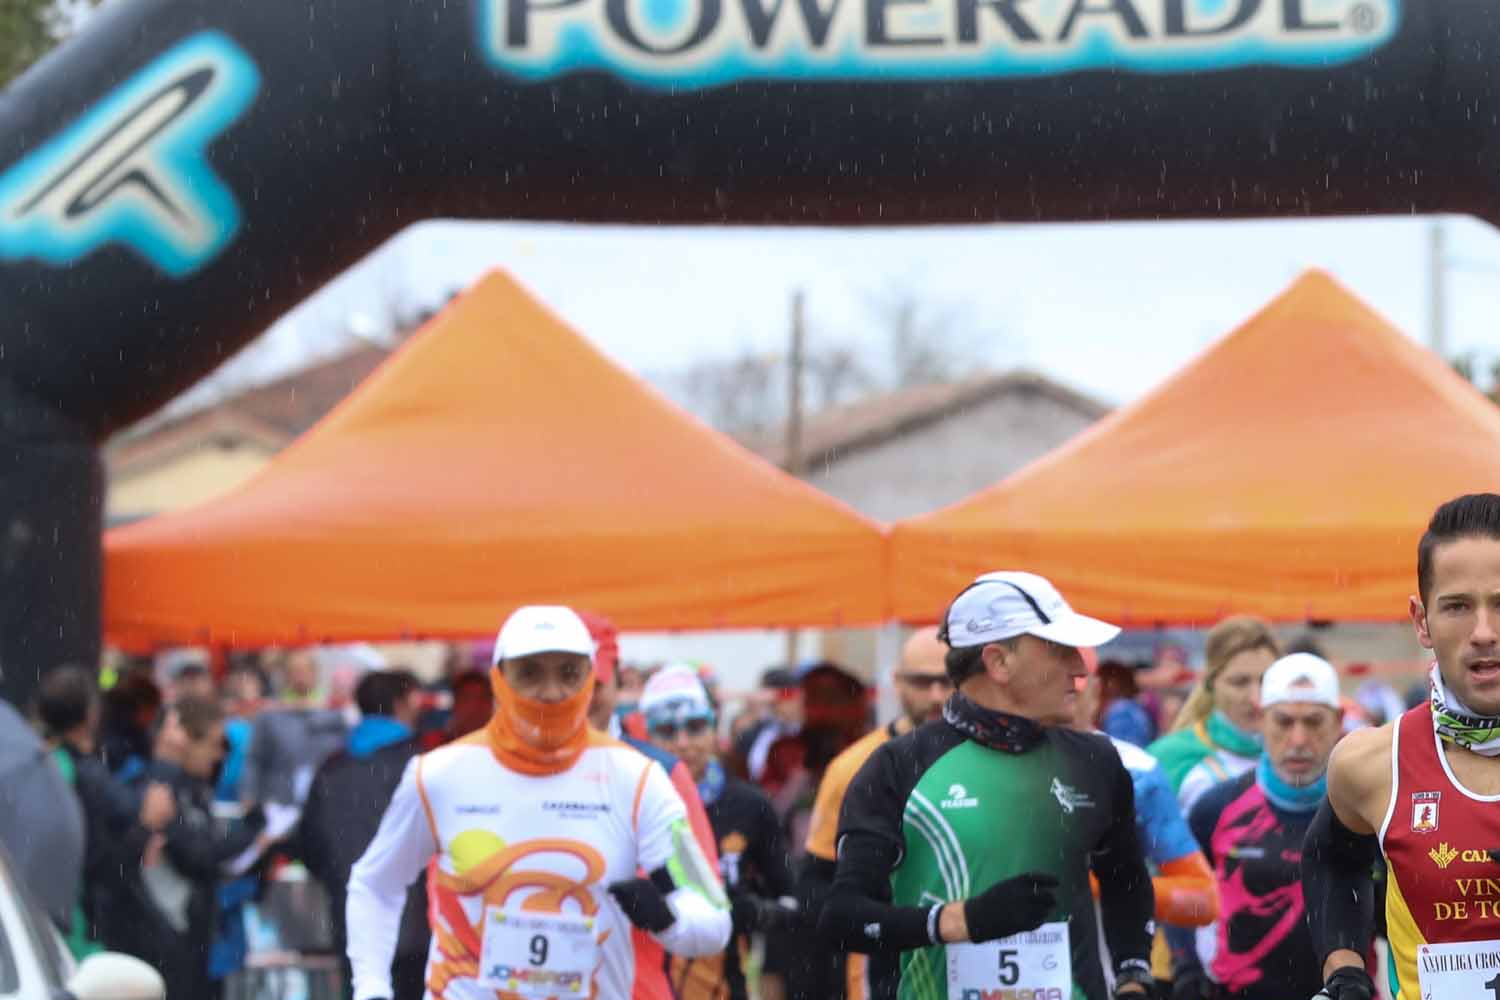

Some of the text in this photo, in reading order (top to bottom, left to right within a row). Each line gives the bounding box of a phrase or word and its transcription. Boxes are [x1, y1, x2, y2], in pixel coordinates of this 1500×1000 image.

[1461, 849, 1491, 863] CAJ
[1433, 902, 1468, 921] DE
[529, 934, 548, 966] 9
[998, 949, 1020, 987] 5
[1450, 953, 1473, 972] LIGA
